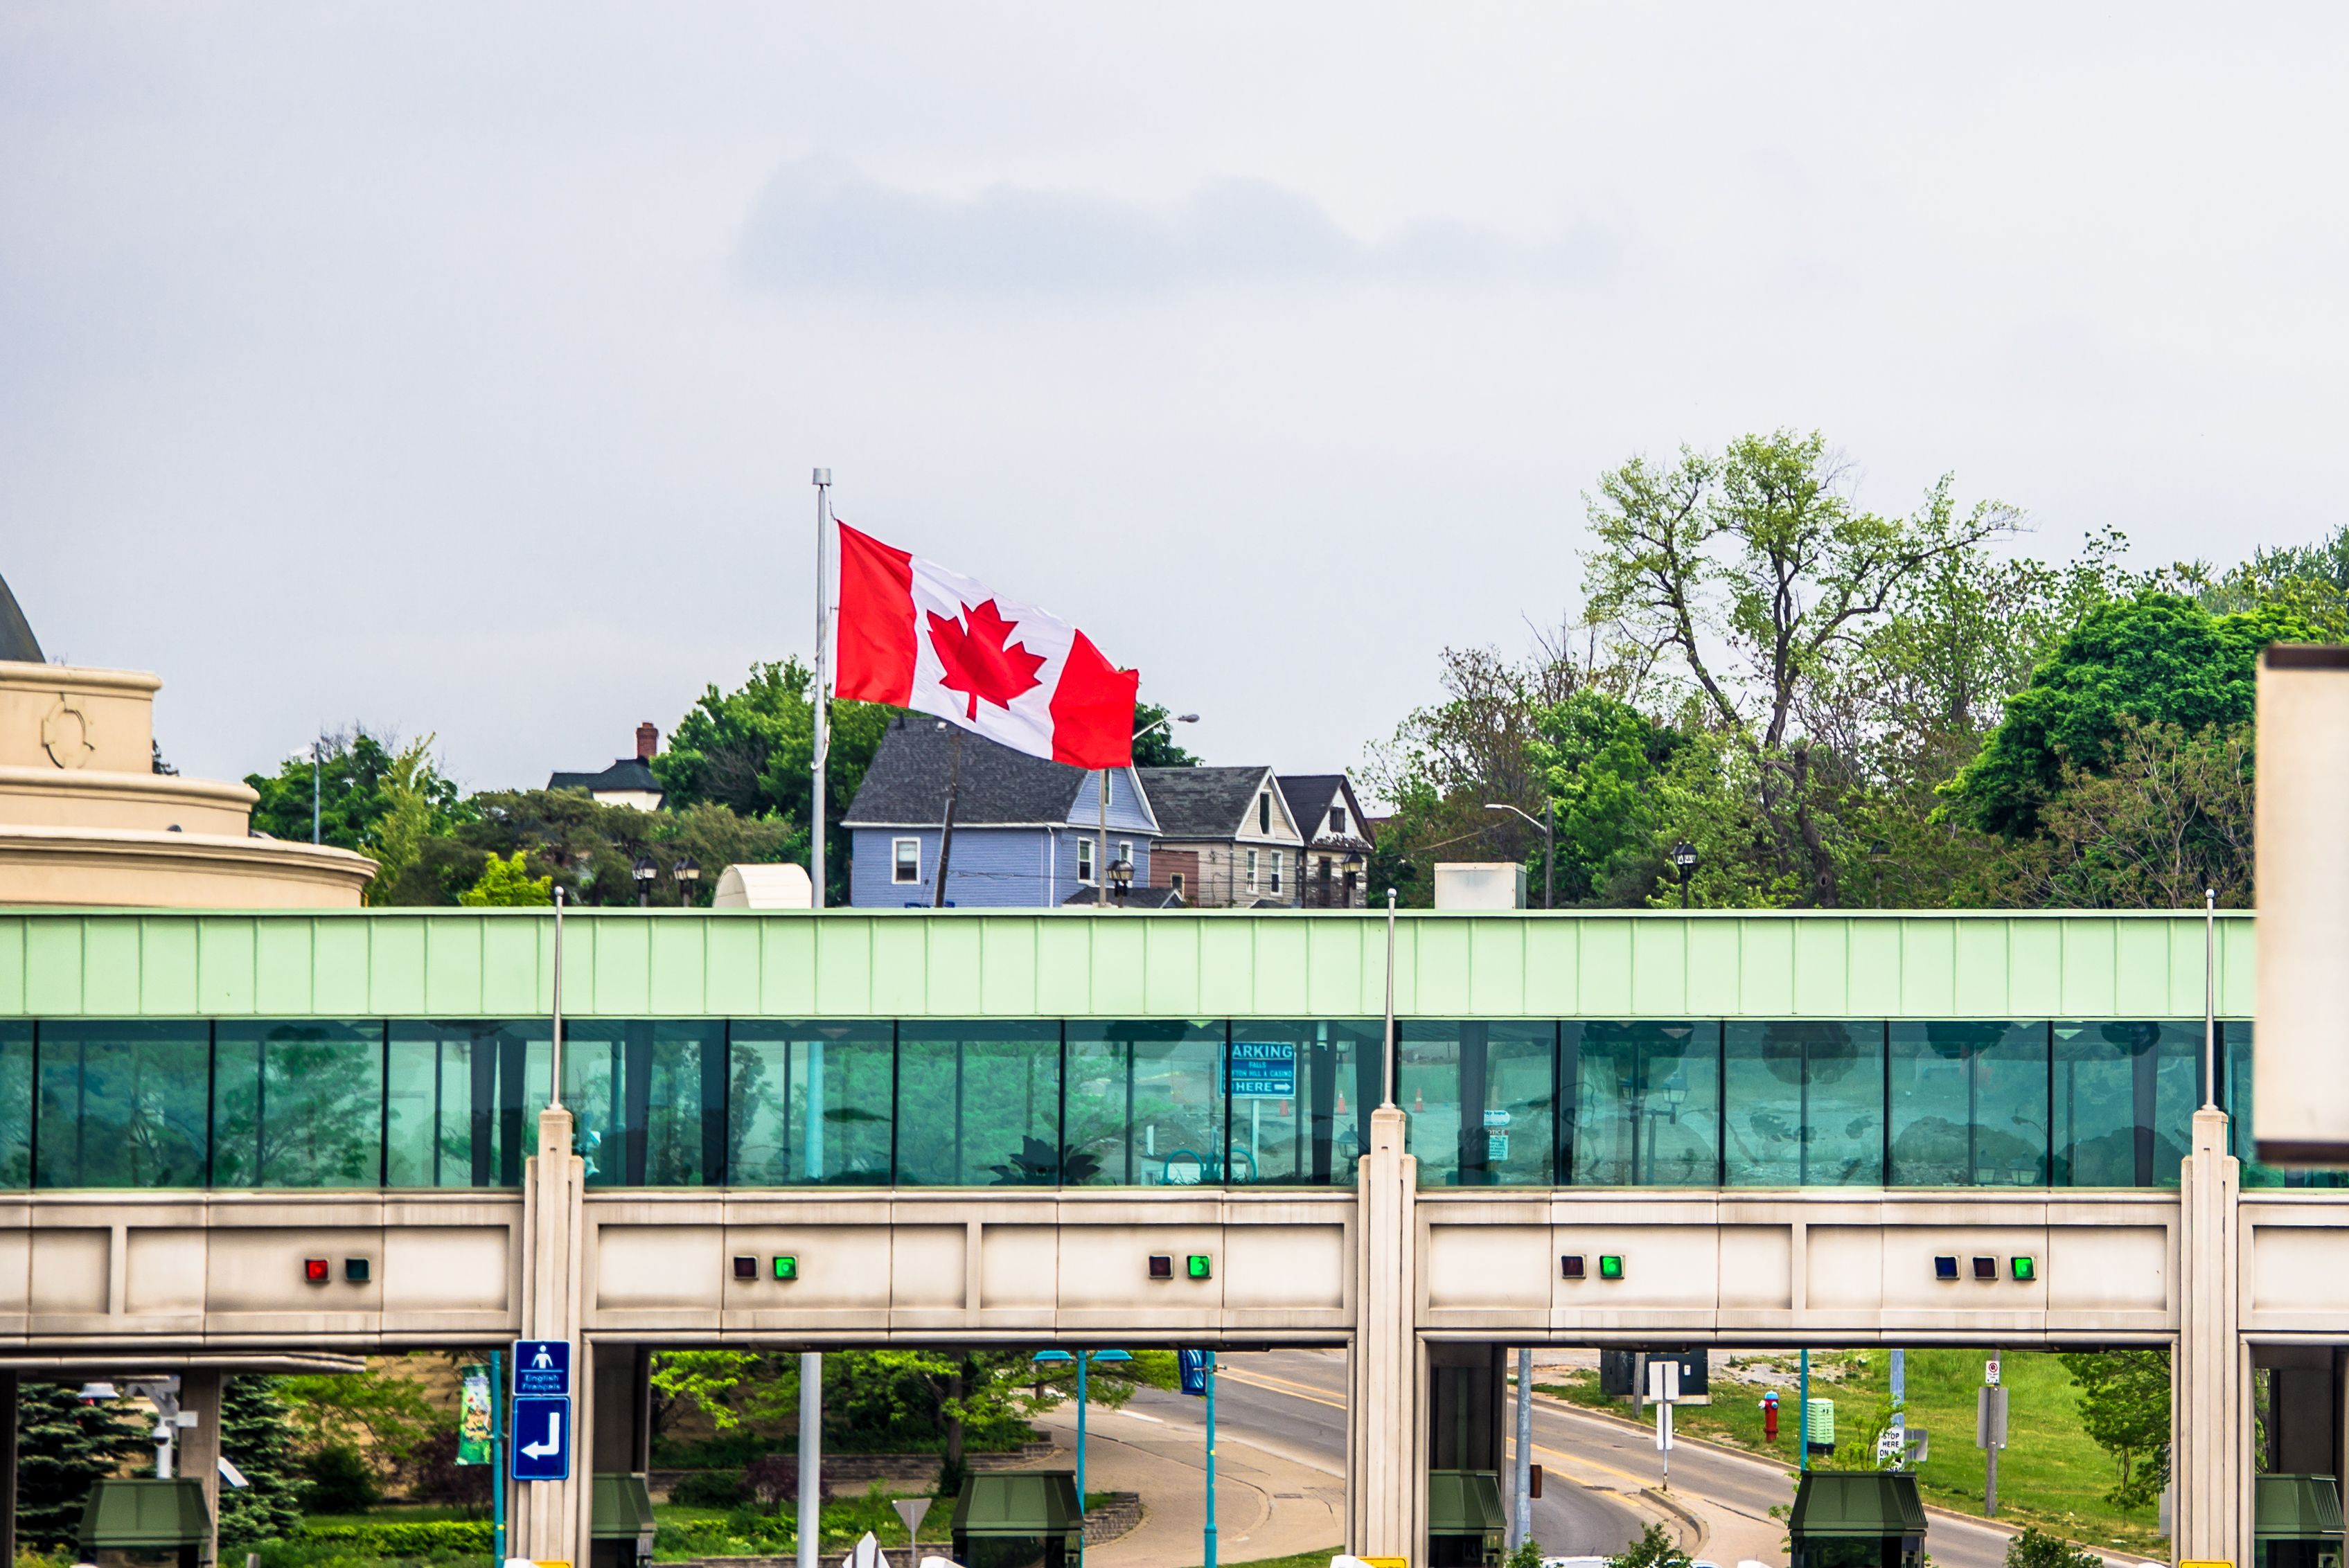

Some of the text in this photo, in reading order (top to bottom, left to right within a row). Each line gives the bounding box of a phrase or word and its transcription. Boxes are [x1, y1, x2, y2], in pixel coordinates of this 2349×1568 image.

[1224, 1044, 1293, 1058] ARKING
[1236, 1082, 1272, 1092] HERE
[525, 1375, 559, 1383] English
